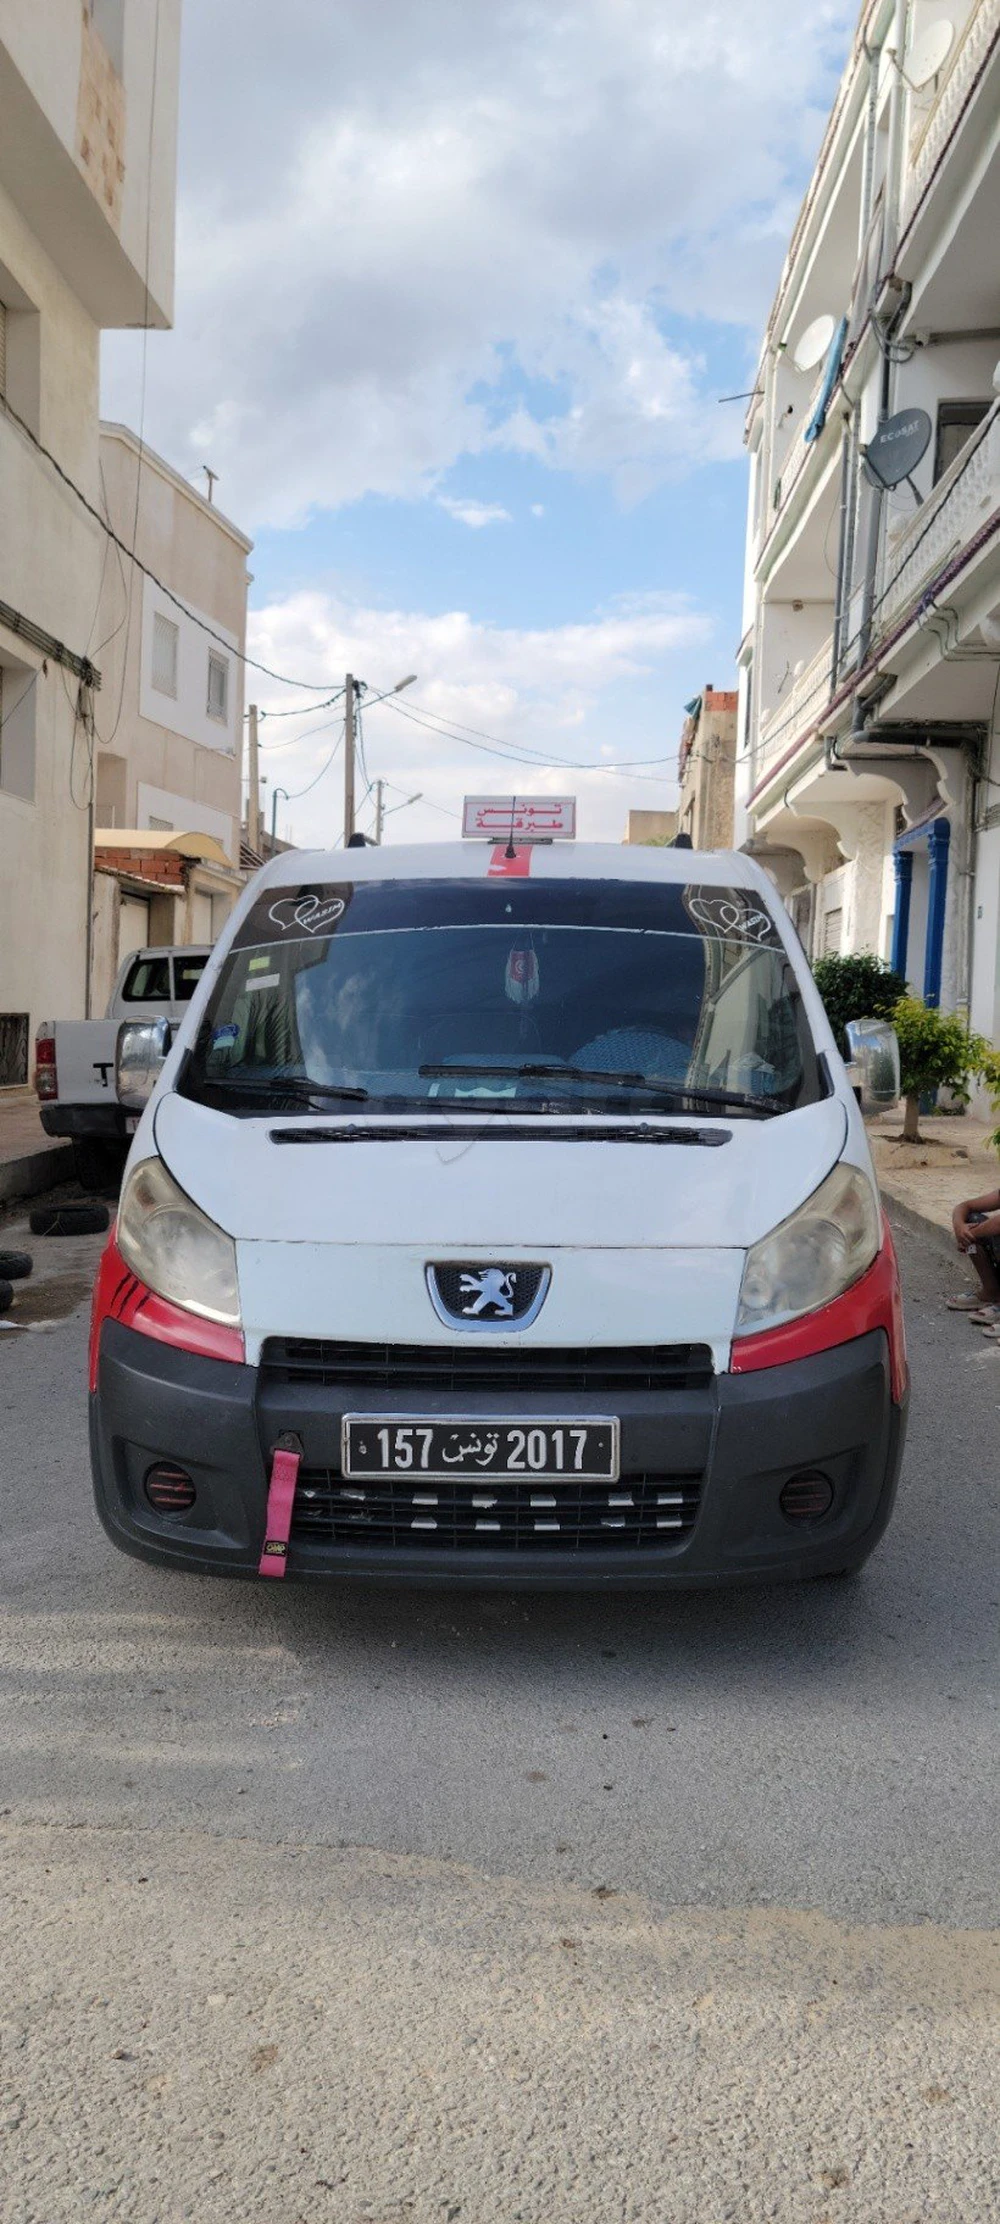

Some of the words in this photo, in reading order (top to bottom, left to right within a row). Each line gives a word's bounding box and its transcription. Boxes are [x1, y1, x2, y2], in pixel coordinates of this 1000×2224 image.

[377, 1429, 433, 1469] 157
[442, 1433, 499, 1467] تونس
[506, 1430, 587, 1470] 2017
